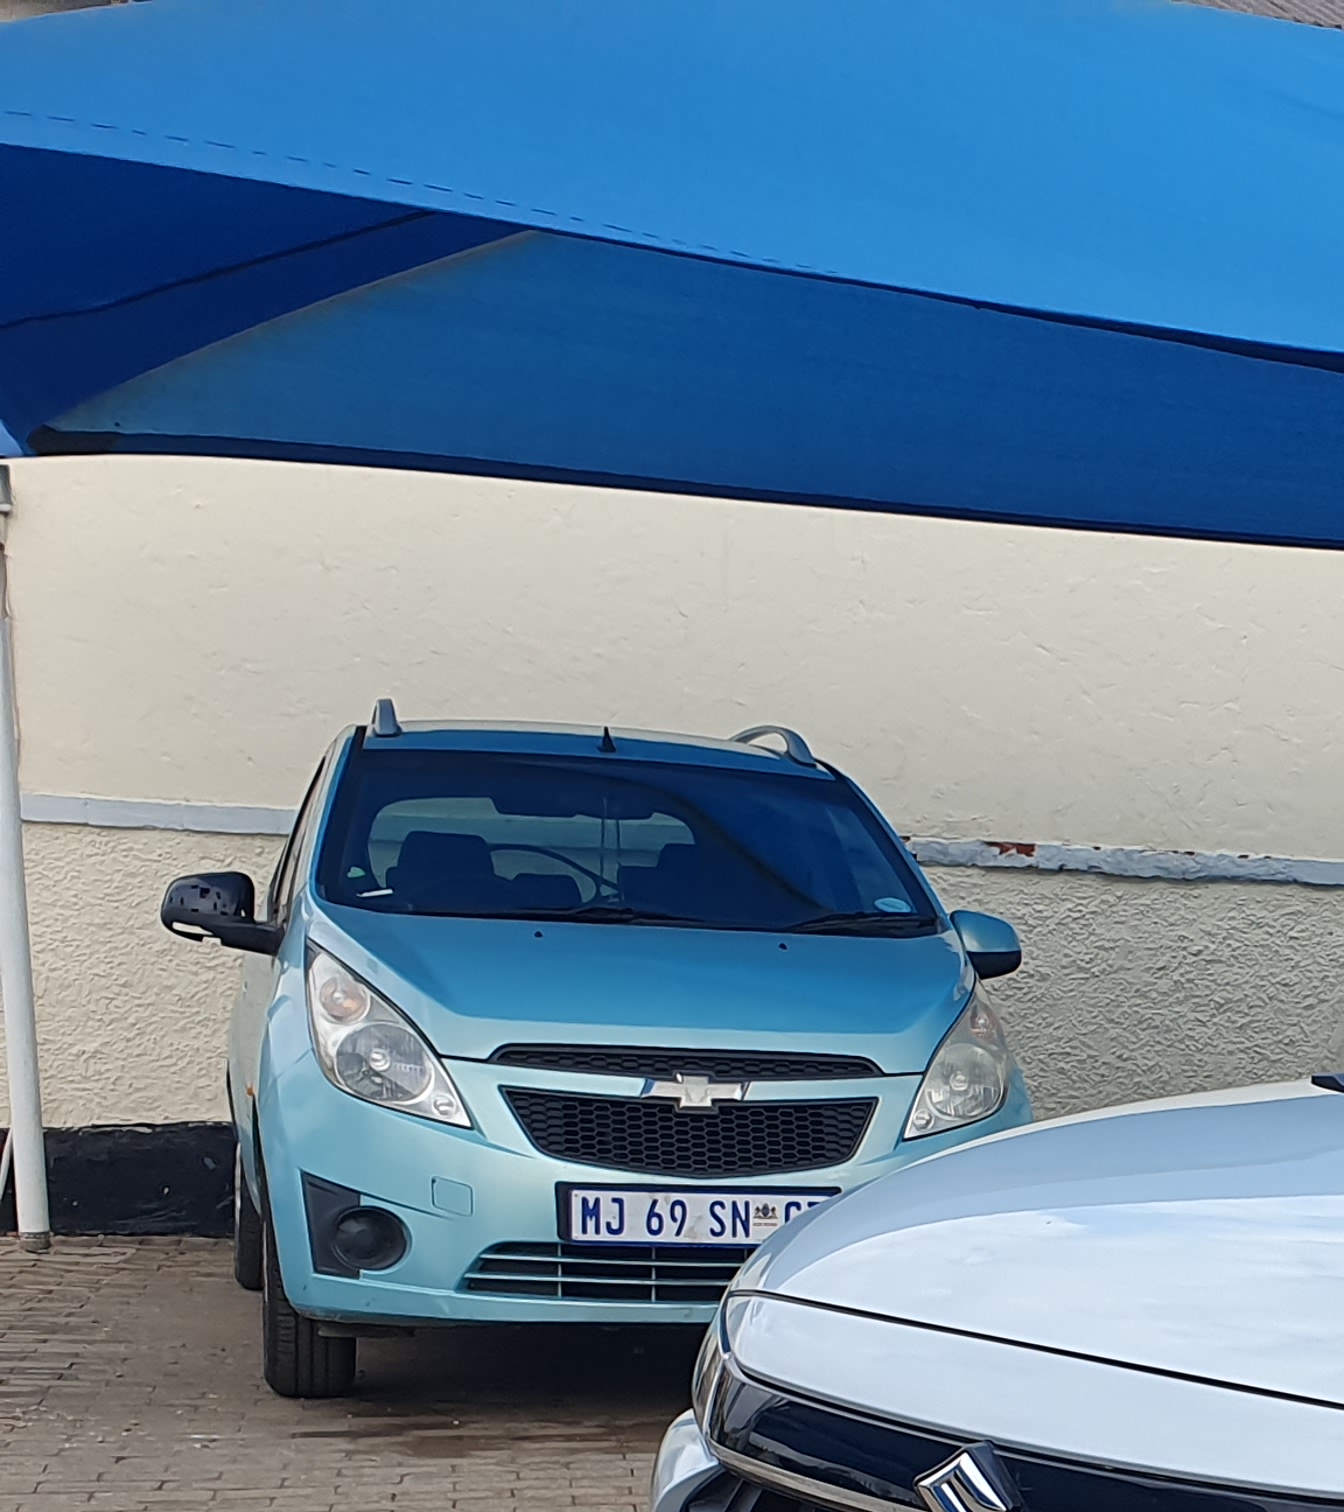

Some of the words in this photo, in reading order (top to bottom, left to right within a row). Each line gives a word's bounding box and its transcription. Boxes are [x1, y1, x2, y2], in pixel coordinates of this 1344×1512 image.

[581, 1196, 625, 1236] MJ
[646, 1198, 687, 1237] 69
[709, 1200, 750, 1238] SN
